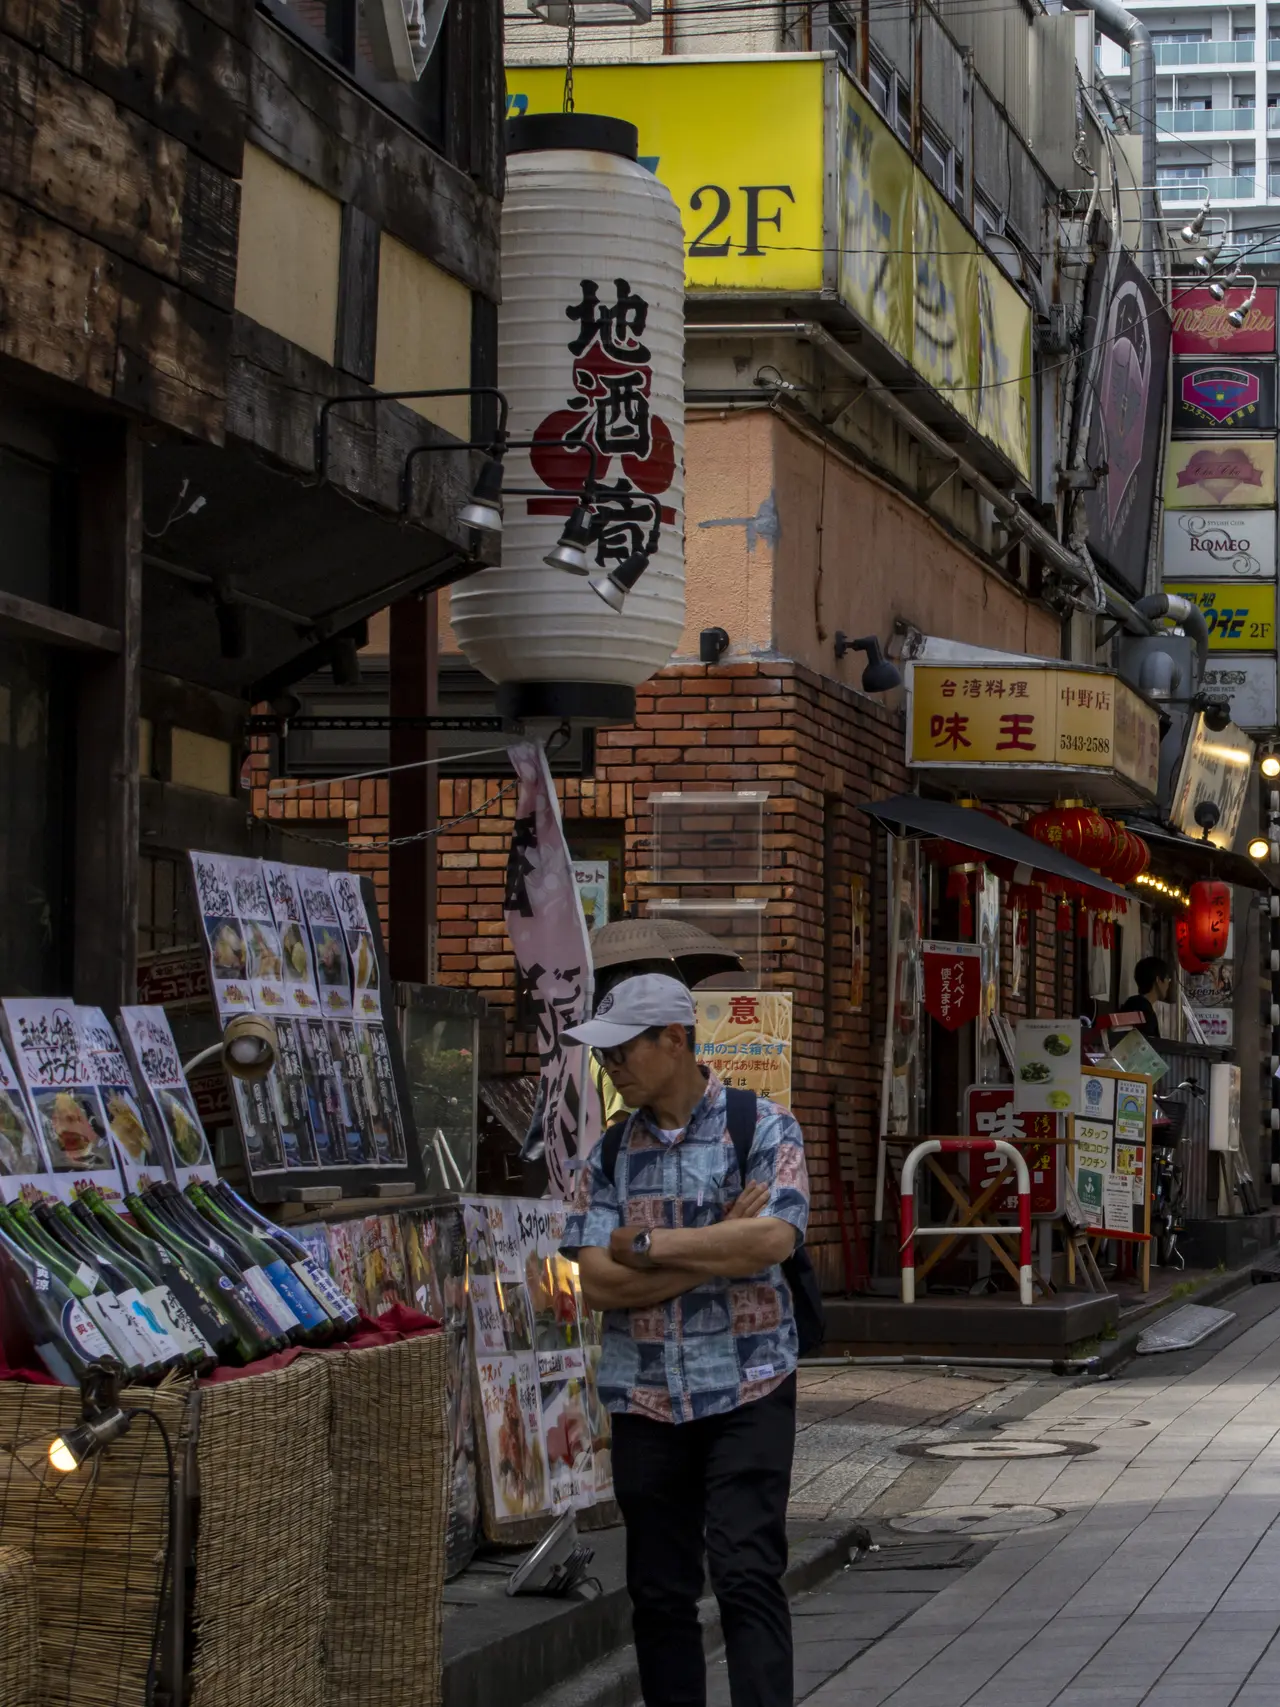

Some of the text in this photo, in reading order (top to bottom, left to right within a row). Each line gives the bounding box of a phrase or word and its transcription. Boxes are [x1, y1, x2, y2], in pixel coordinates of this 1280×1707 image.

[688, 184, 795, 257] 2F
[1250, 623, 1271, 638] 2F
[940, 679, 1029, 699] 台湾料理
[1061, 687, 1111, 711] 中野店
[930, 712, 1036, 751] 味王
[1060, 734, 1110, 753] 5343-2588
[941, 967, 952, 1021] 使えます。
[953, 961, 965, 1008] ペイペイ
[1080, 1127, 1109, 1140] スタッフ
